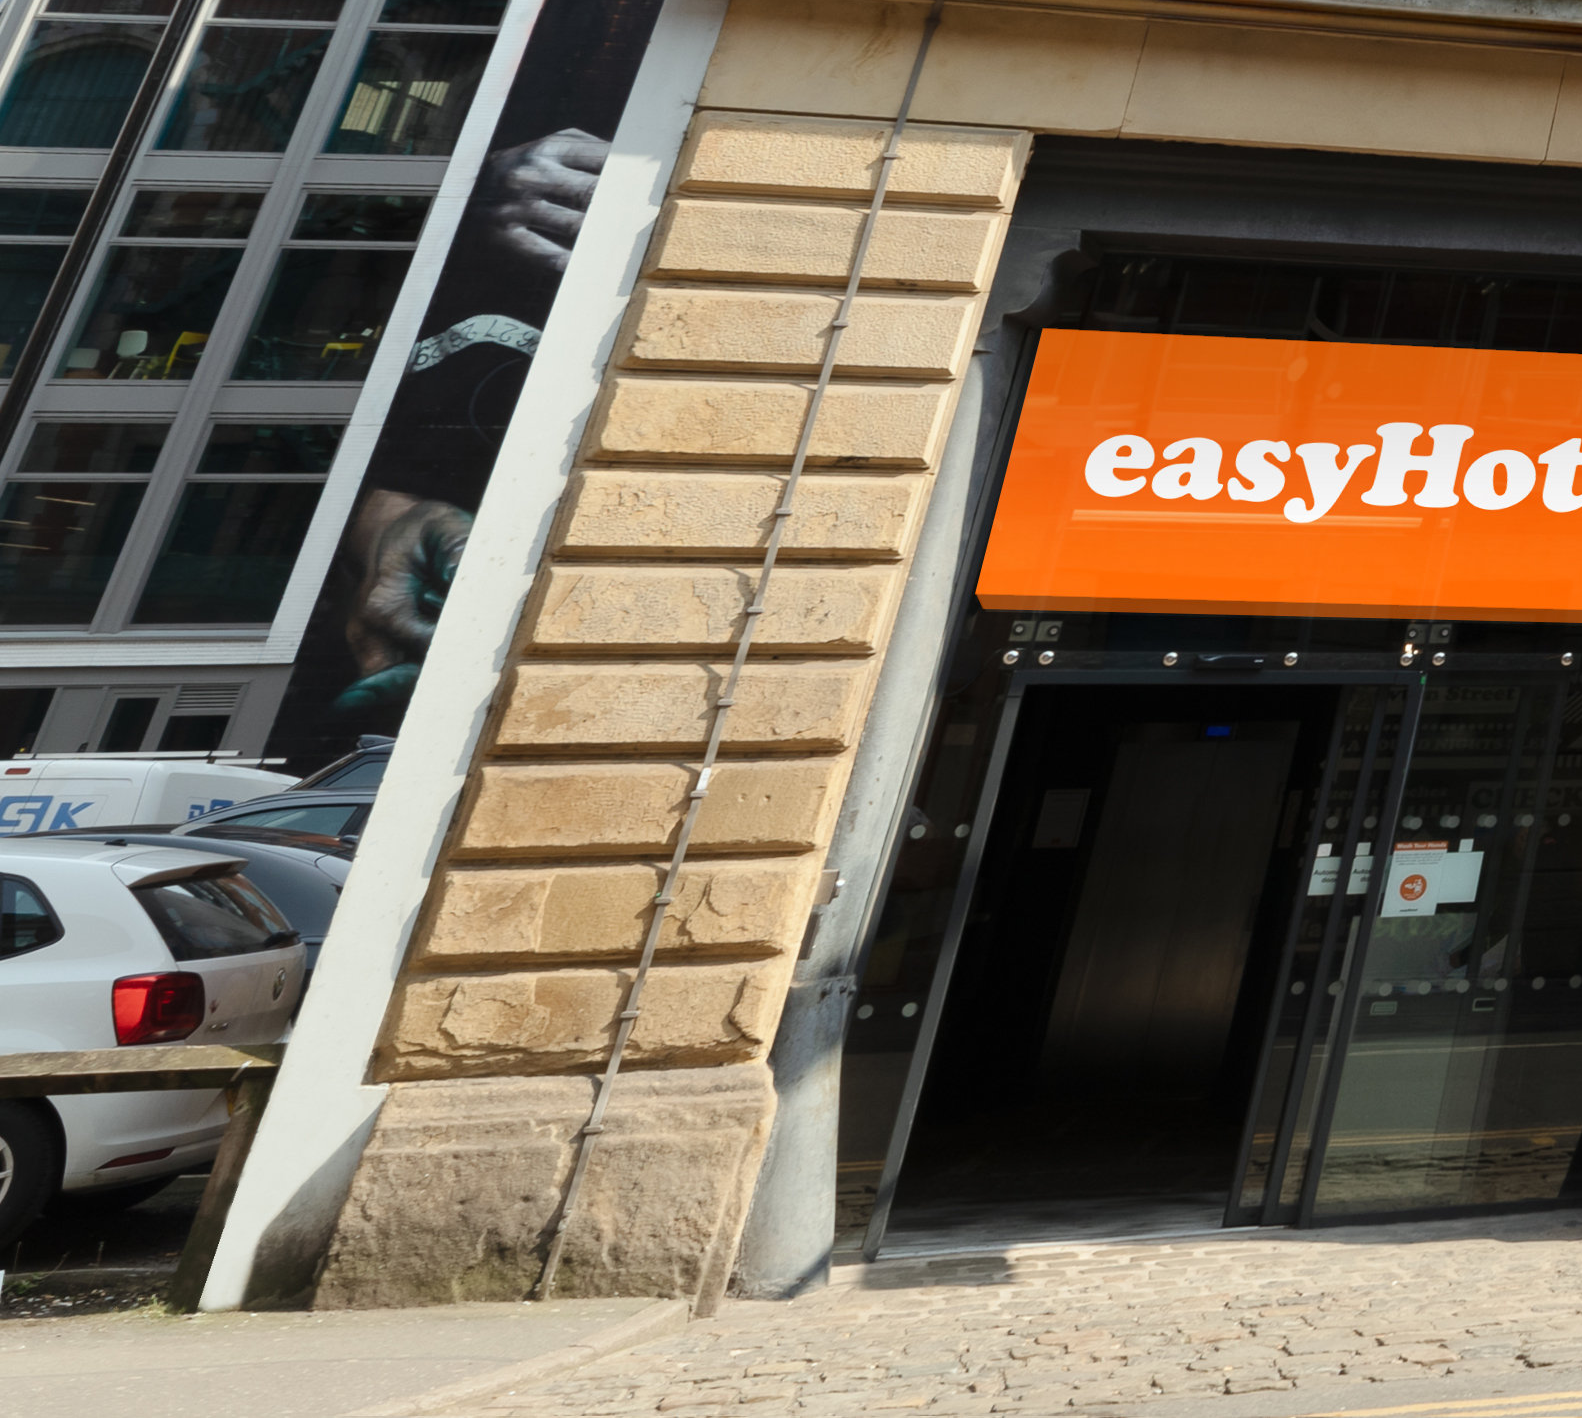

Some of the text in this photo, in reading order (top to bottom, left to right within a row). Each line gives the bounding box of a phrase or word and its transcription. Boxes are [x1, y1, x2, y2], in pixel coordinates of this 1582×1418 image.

[483, 319, 519, 343] 27
[413, 338, 443, 366] 29
[1446, 686, 1515, 702] Street
